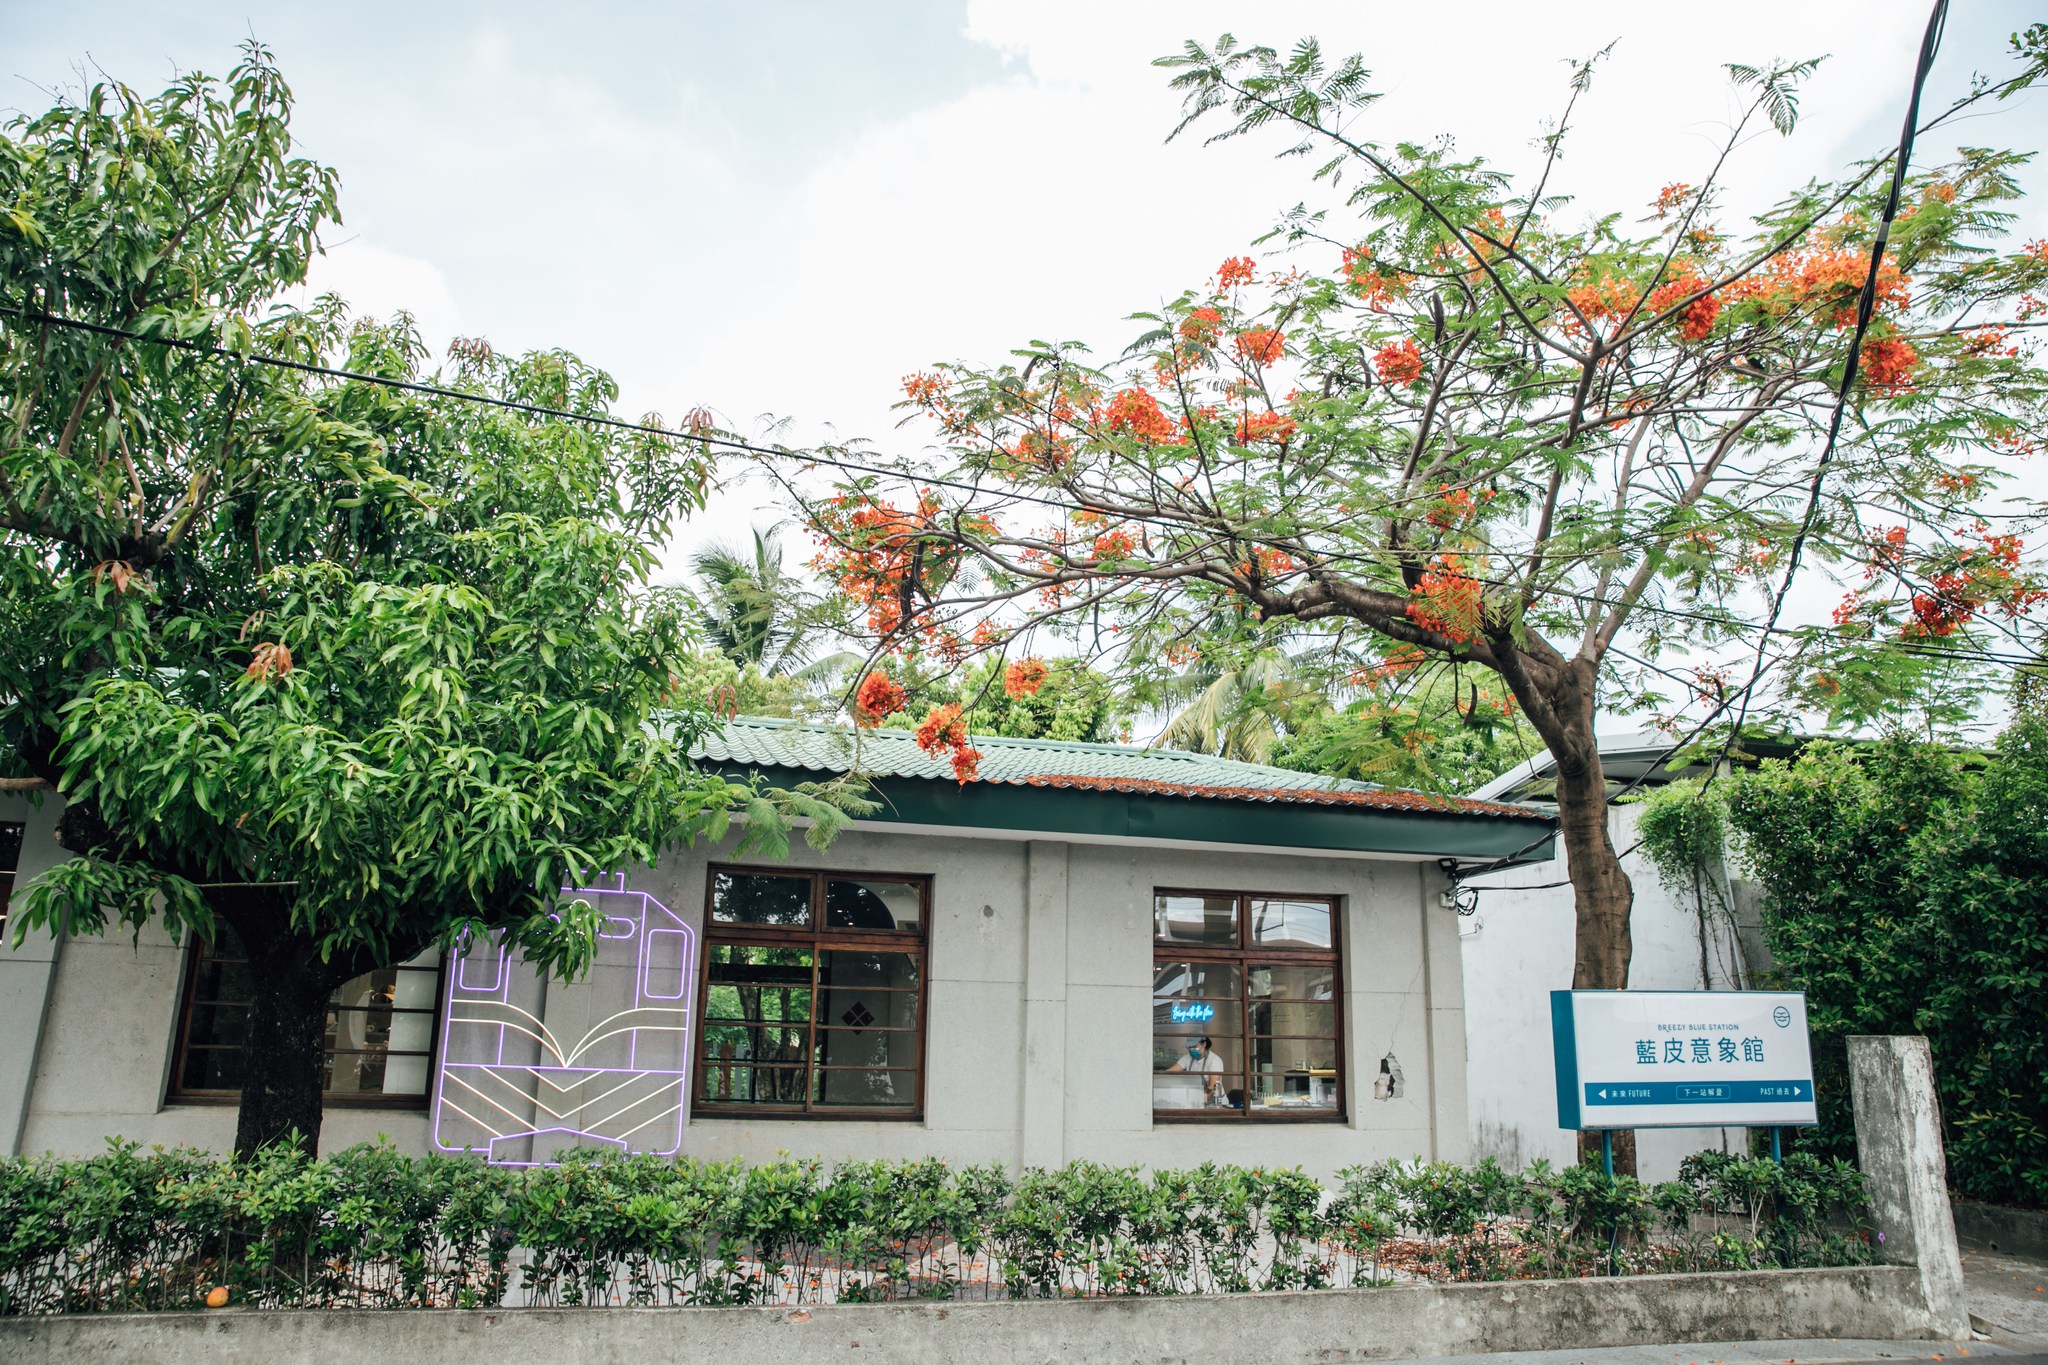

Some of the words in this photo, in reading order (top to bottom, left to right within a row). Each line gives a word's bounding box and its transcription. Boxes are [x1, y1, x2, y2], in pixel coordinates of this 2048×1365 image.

[1657, 1024, 1686, 1032] BREEZY
[1708, 1023, 1739, 1031] STATION
[1635, 1036, 1764, 1064] 藍皮意象館
[1628, 1089, 1651, 1098] FUTURE
[1760, 1087, 1775, 1096] PAST
